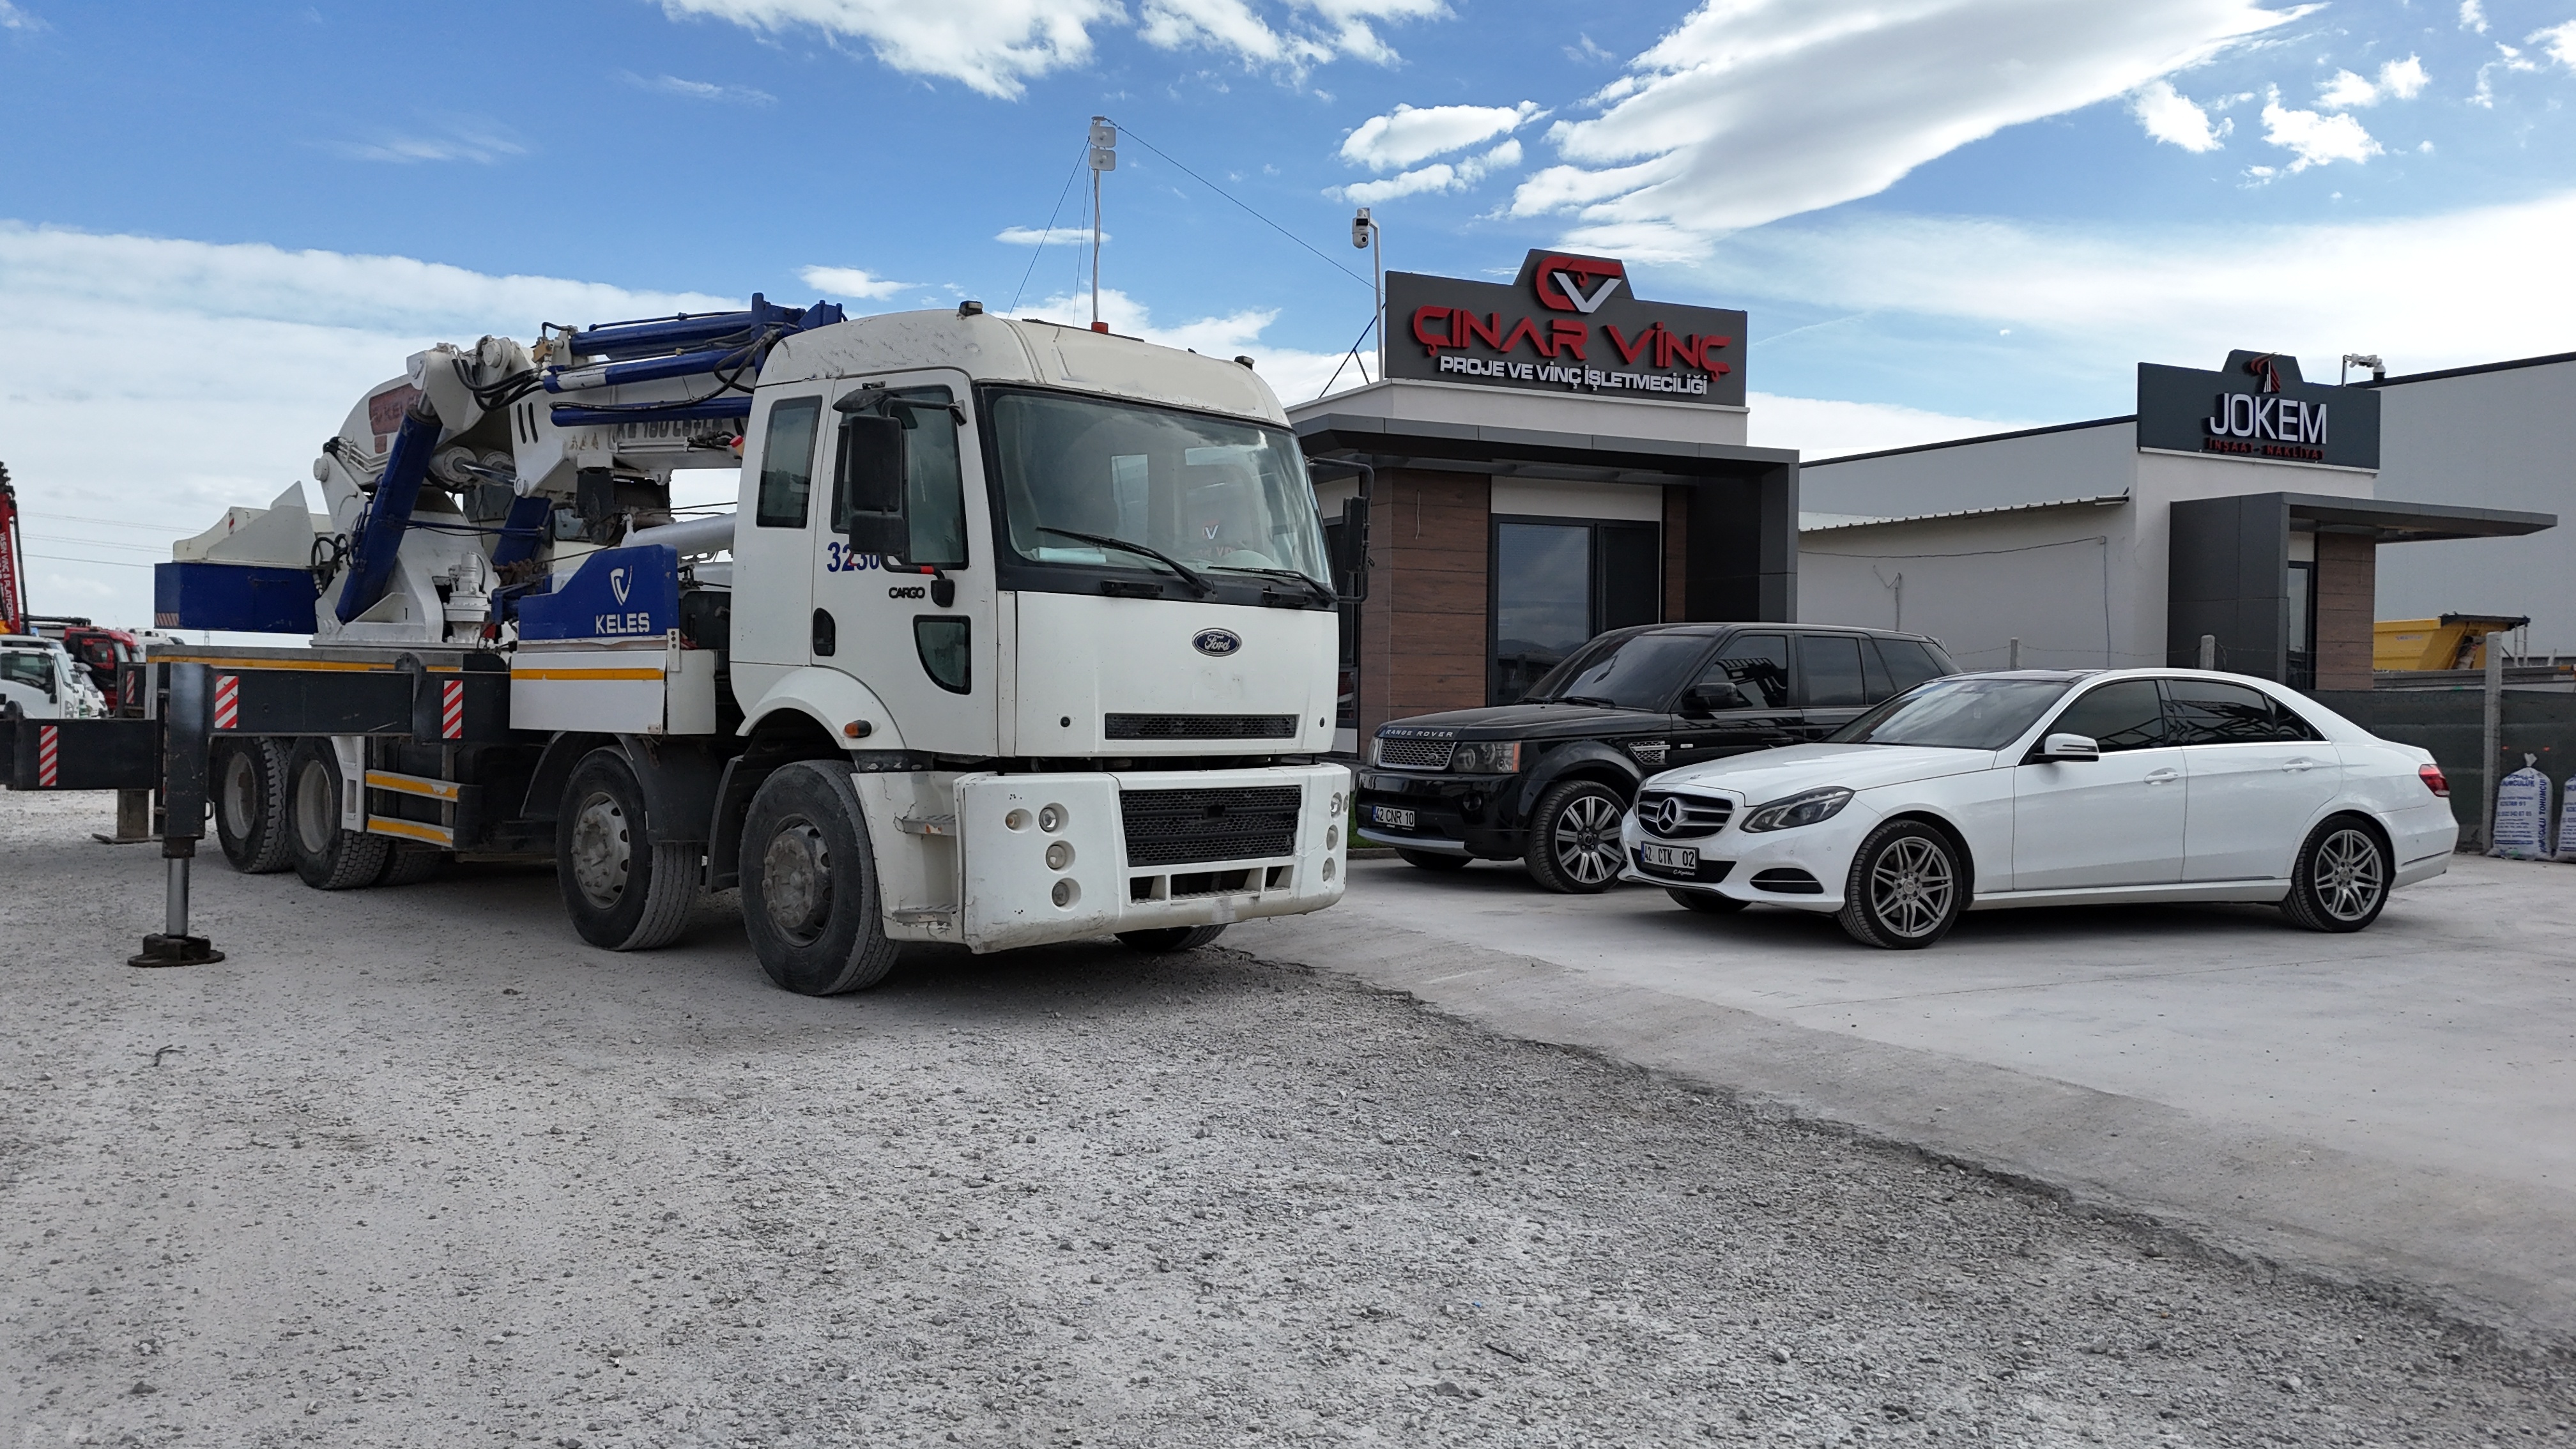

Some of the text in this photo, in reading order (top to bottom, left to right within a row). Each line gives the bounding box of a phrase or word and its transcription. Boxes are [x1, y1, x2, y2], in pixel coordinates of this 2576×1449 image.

[1413, 305, 1731, 383] ÇINAR VİNÇ
[1440, 355, 1708, 395] PROJE VE VİNÇ İŞLETMECİLİĞİ
[2210, 392, 2327, 444] JOKEM
[888, 586, 926, 599] CARGO
[1204, 634, 1230, 651] Ford
[1376, 808, 1414, 825] 42 CNR 10
[1644, 845, 1694, 868] 42 CTK 02
